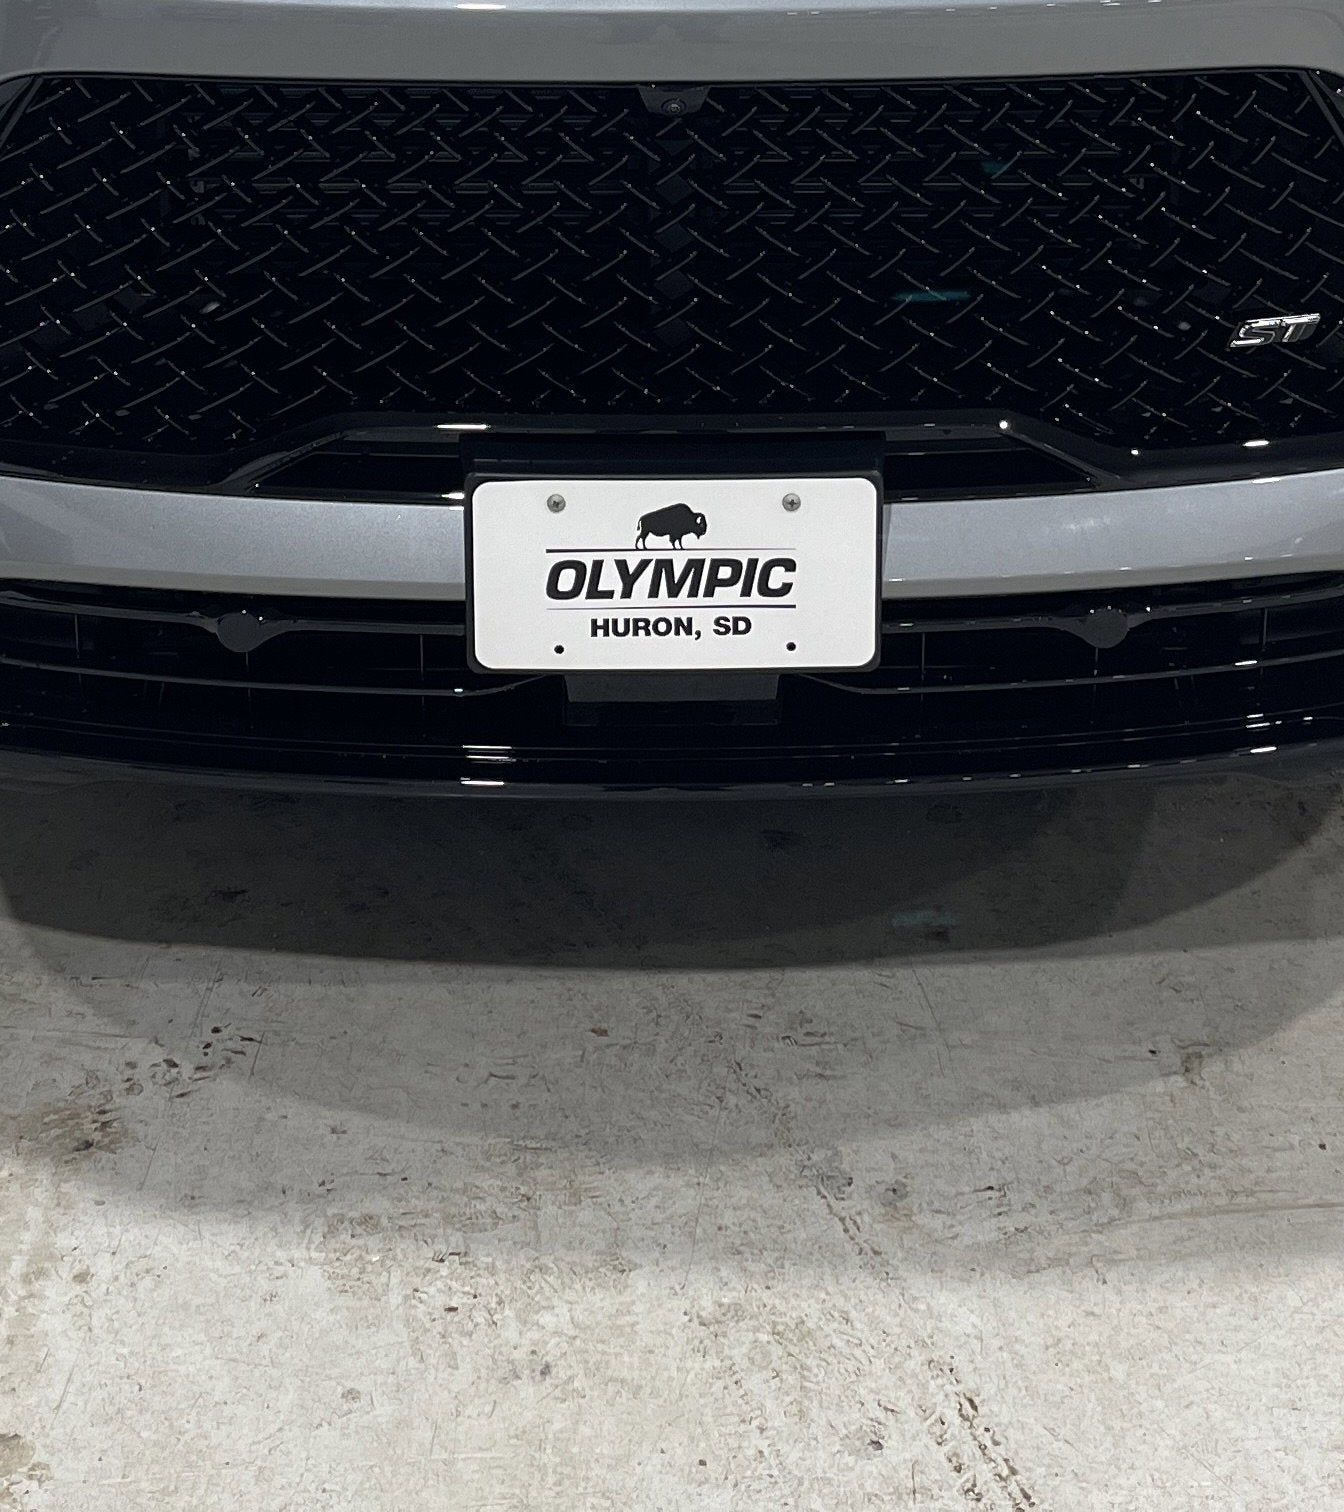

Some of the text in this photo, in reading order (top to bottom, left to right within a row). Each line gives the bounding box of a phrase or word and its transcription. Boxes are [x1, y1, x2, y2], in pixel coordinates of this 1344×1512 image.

[1228, 313, 1321, 348] ST
[546, 557, 797, 600] OLYMPIC
[590, 615, 752, 640] HURON, SD
